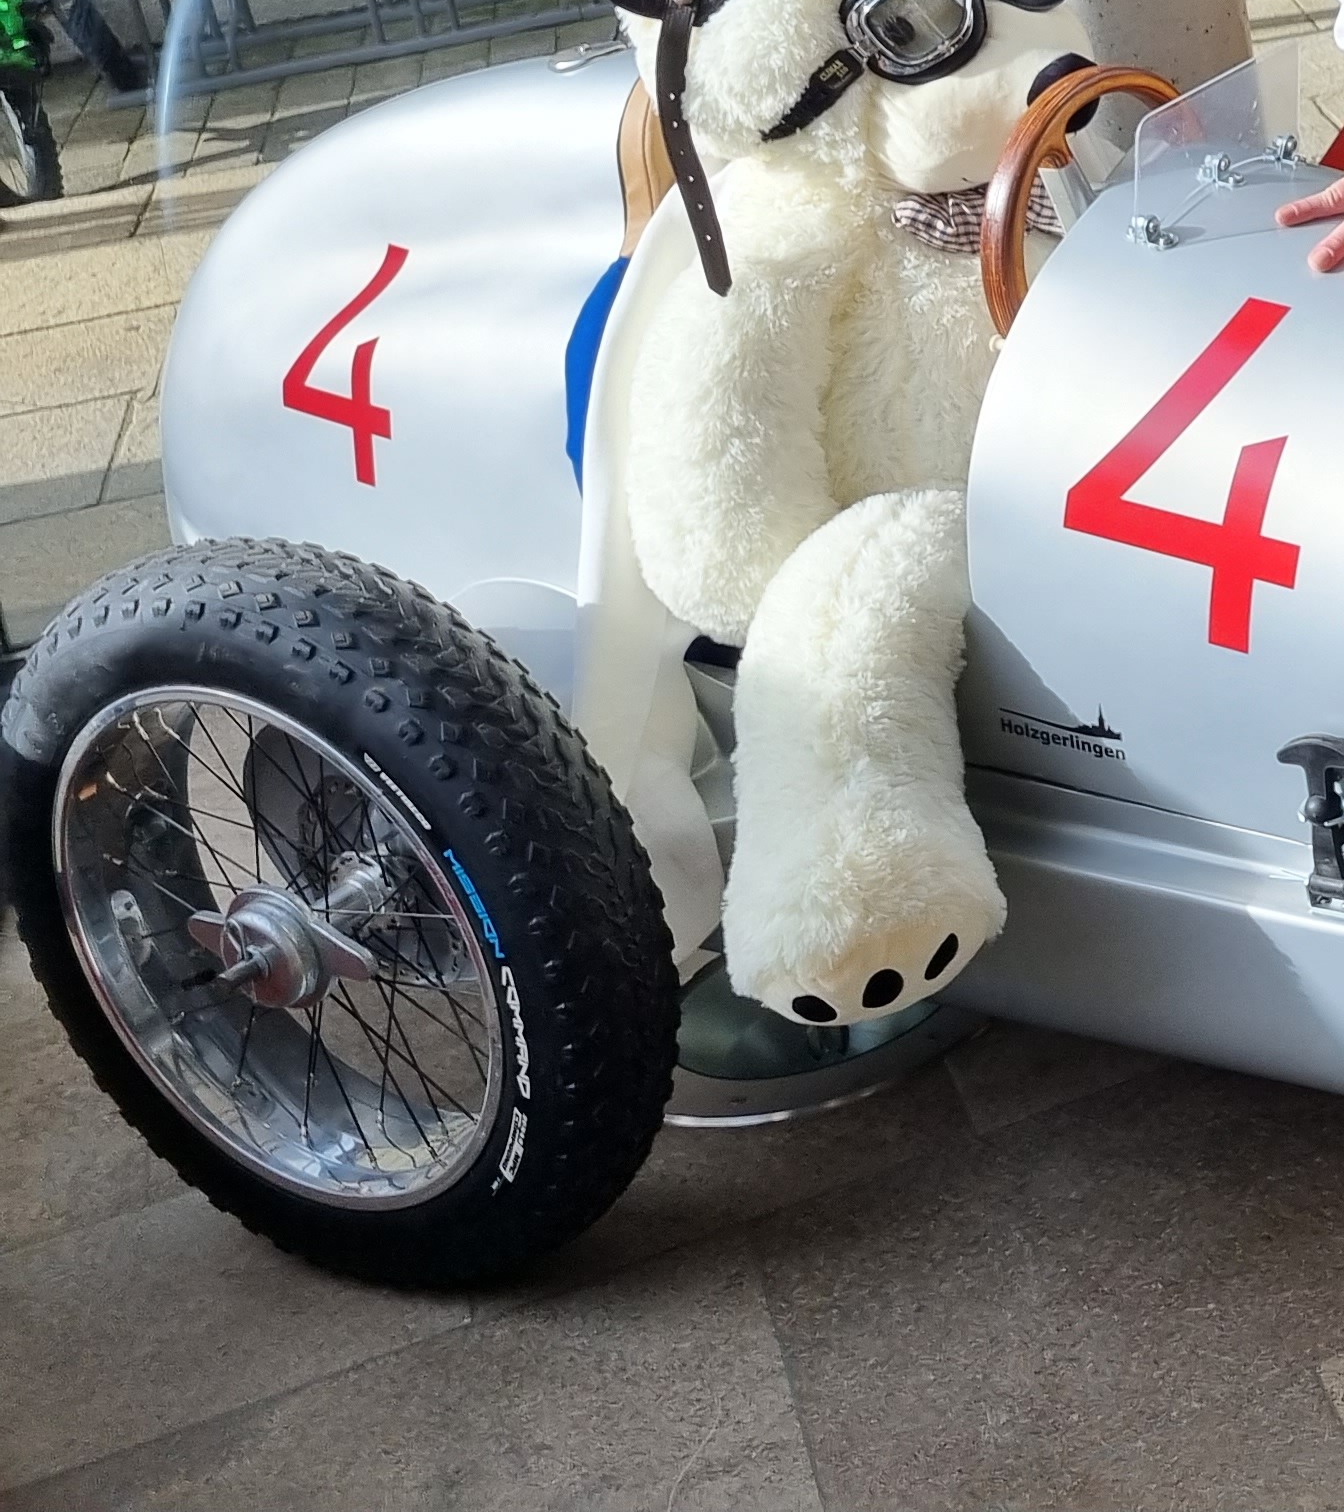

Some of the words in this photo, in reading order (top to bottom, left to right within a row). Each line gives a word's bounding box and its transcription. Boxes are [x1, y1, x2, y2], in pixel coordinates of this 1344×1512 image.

[282, 243, 409, 487] 4
[1063, 296, 1301, 654] 4
[1000, 717, 1126, 761] Holzgerlingen
[443, 848, 505, 959] MISSION
[502, 965, 530, 1100] COMMAND
